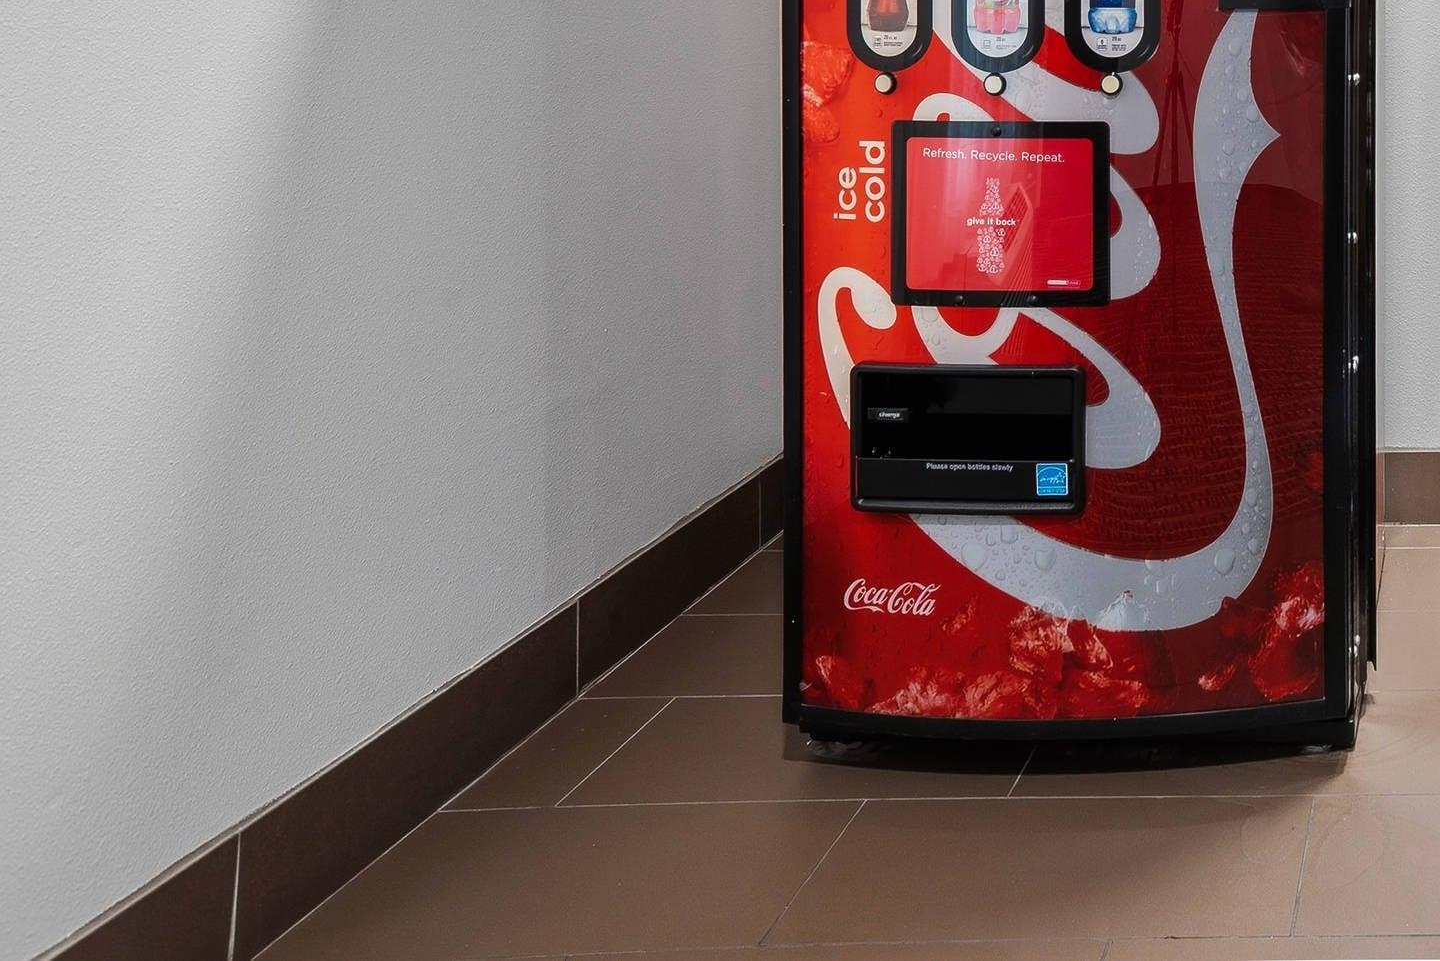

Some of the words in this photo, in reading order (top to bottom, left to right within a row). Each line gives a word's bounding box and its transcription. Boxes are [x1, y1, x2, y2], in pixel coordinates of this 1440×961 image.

[923, 148, 967, 160] Refresh.
[970, 150, 1018, 162] Recycle.
[1021, 152, 1065, 164] Repeat.
[833, 166, 857, 220] ice
[859, 141, 885, 222] cold
[967, 218, 985, 227] give
[987, 217, 994, 226] it
[996, 217, 1016, 226] back
[926, 462, 948, 471] Please
[949, 464, 966, 472] open
[967, 463, 991, 471] bottles
[992, 463, 1013, 472] slowly
[843, 578, 941, 616] Coca-Cola
